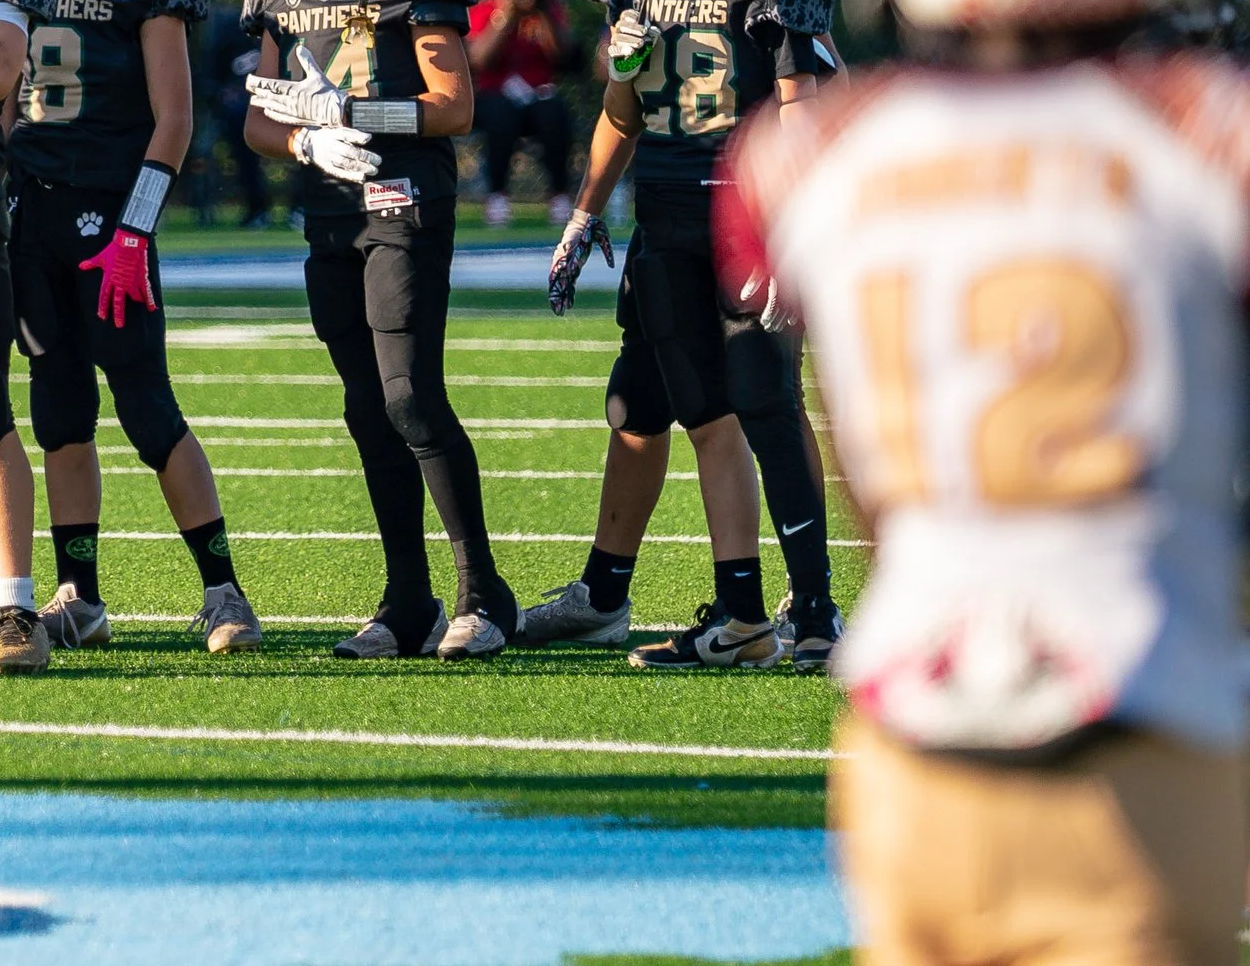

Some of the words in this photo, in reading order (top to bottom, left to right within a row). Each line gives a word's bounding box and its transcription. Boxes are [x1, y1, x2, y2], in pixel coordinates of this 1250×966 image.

[28, 24, 83, 122] 8
[632, 29, 738, 137] 28
[370, 183, 406, 194] Riddell
[858, 262, 1138, 509] 12
